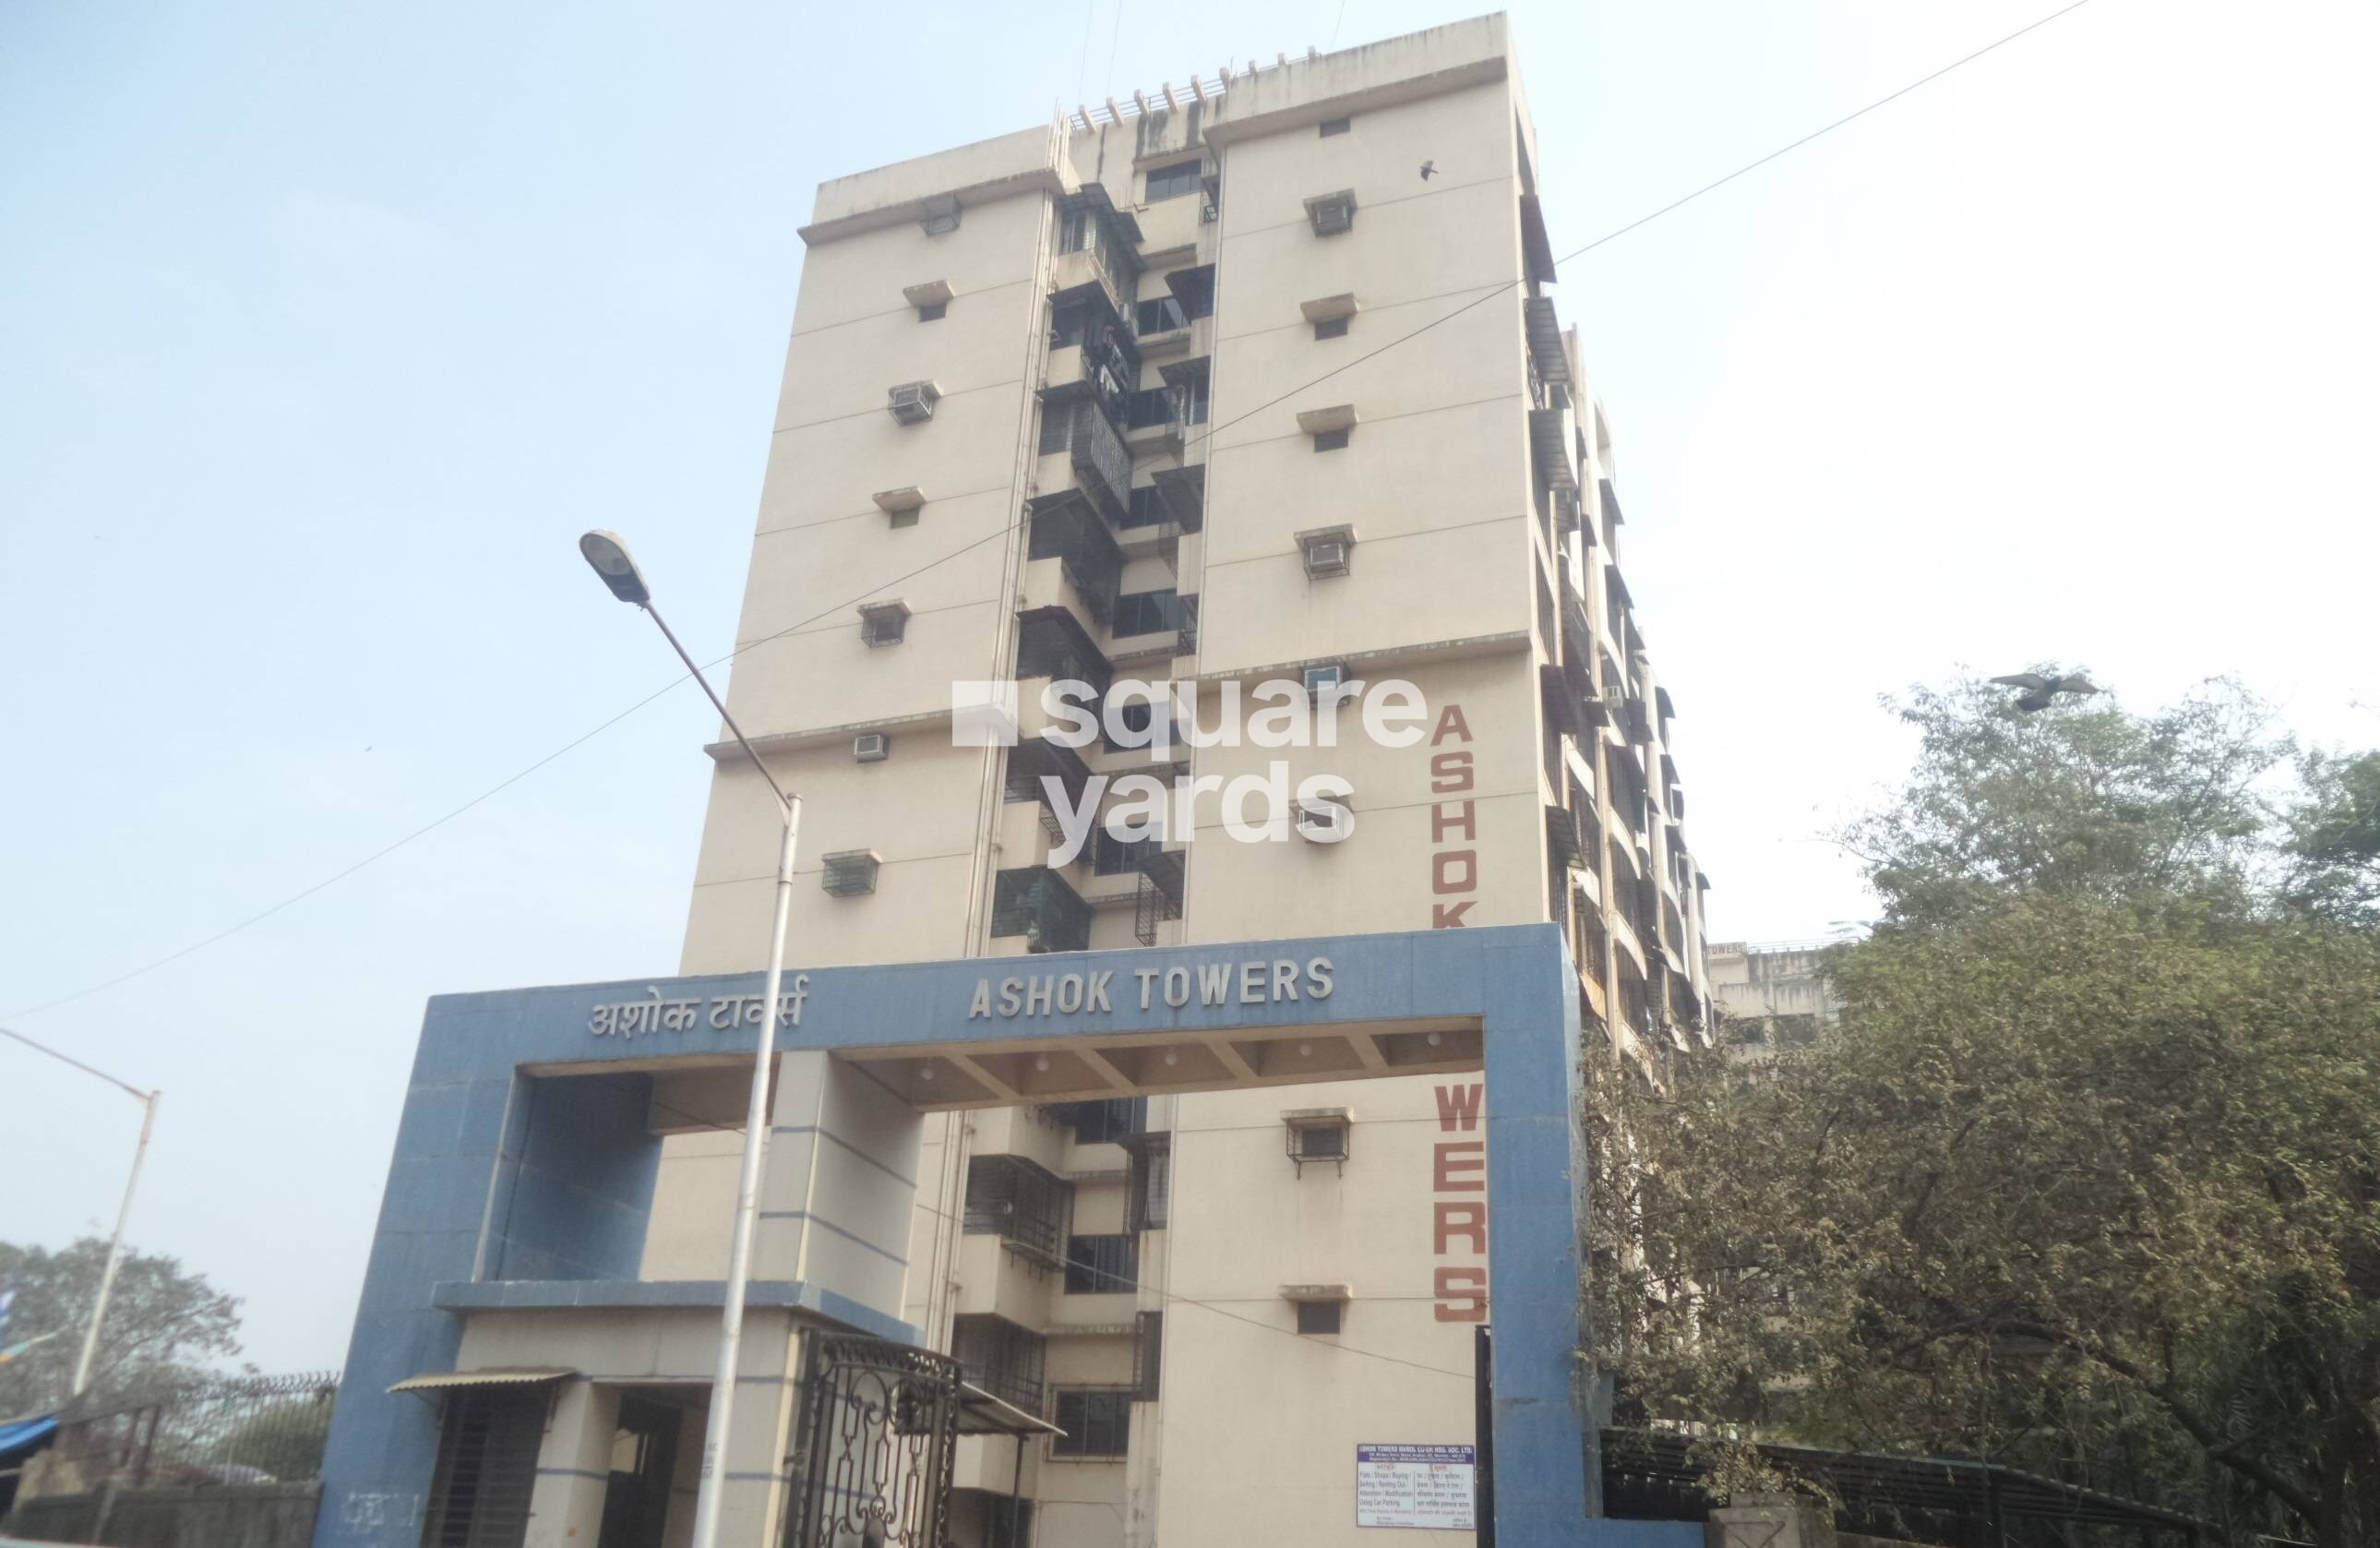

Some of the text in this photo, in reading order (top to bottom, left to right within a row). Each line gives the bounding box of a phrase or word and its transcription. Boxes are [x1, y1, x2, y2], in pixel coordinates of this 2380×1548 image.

[1430, 704, 1478, 929] ASHOK
[588, 984, 701, 1040] अशोक
[968, 956, 1334, 1019] ASHOK TOWERS
[1434, 1084, 1487, 1323] WERS
